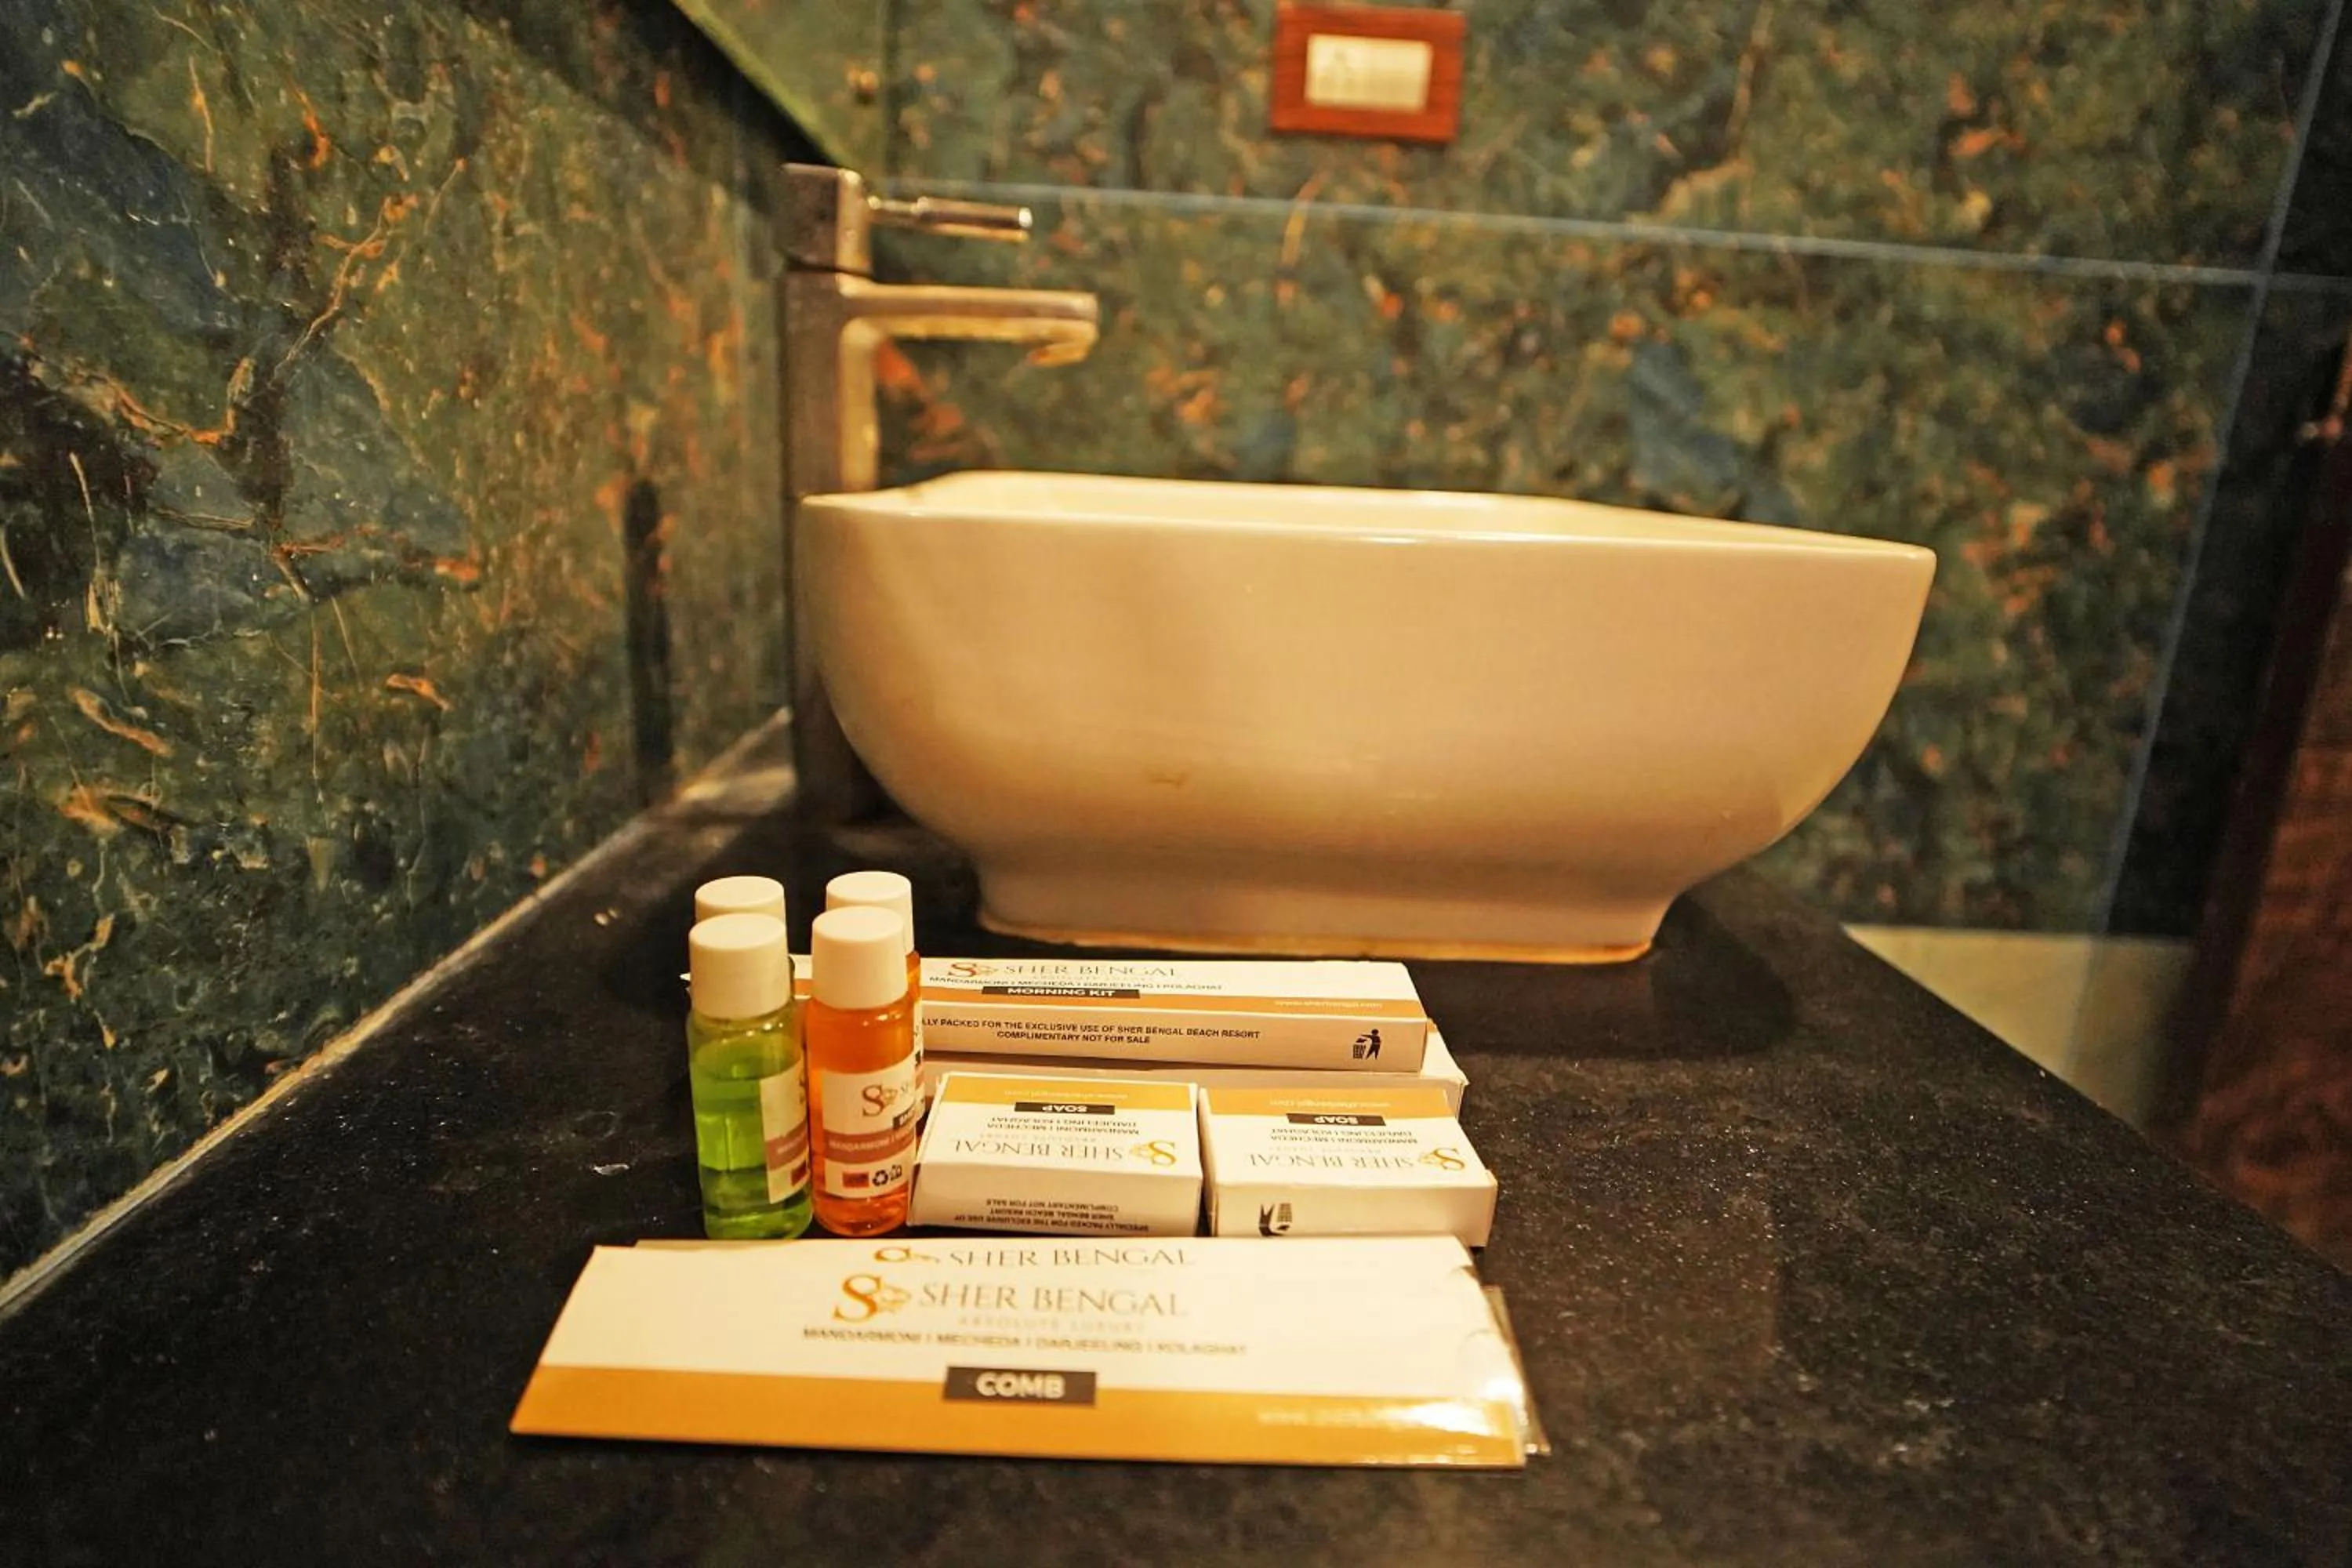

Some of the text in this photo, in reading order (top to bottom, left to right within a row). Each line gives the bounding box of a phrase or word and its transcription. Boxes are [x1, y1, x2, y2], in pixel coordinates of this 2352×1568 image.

[1007, 987, 1086, 996] MORNING
[940, 1018, 979, 1027] PACKED
[1025, 1022, 1078, 1032] EXCLUSIVE
[1117, 1025, 1143, 1034] SHER
[1145, 1026, 1184, 1036] BENGAL
[1186, 1029, 1220, 1037] BEACH
[1221, 1029, 1261, 1039] RESORT
[996, 1030, 1081, 1041] COMPLIMENTARY
[1082, 1033, 1102, 1042] NOT
[1126, 1036, 1151, 1044] SALE
[1041, 1105, 1088, 1113] SOAP
[1313, 1116, 1359, 1124] SOAP
[918, 1282, 1020, 1310] SHER
[1033, 1287, 1189, 1317] BENGAL
[975, 1371, 1065, 1399] COMB
